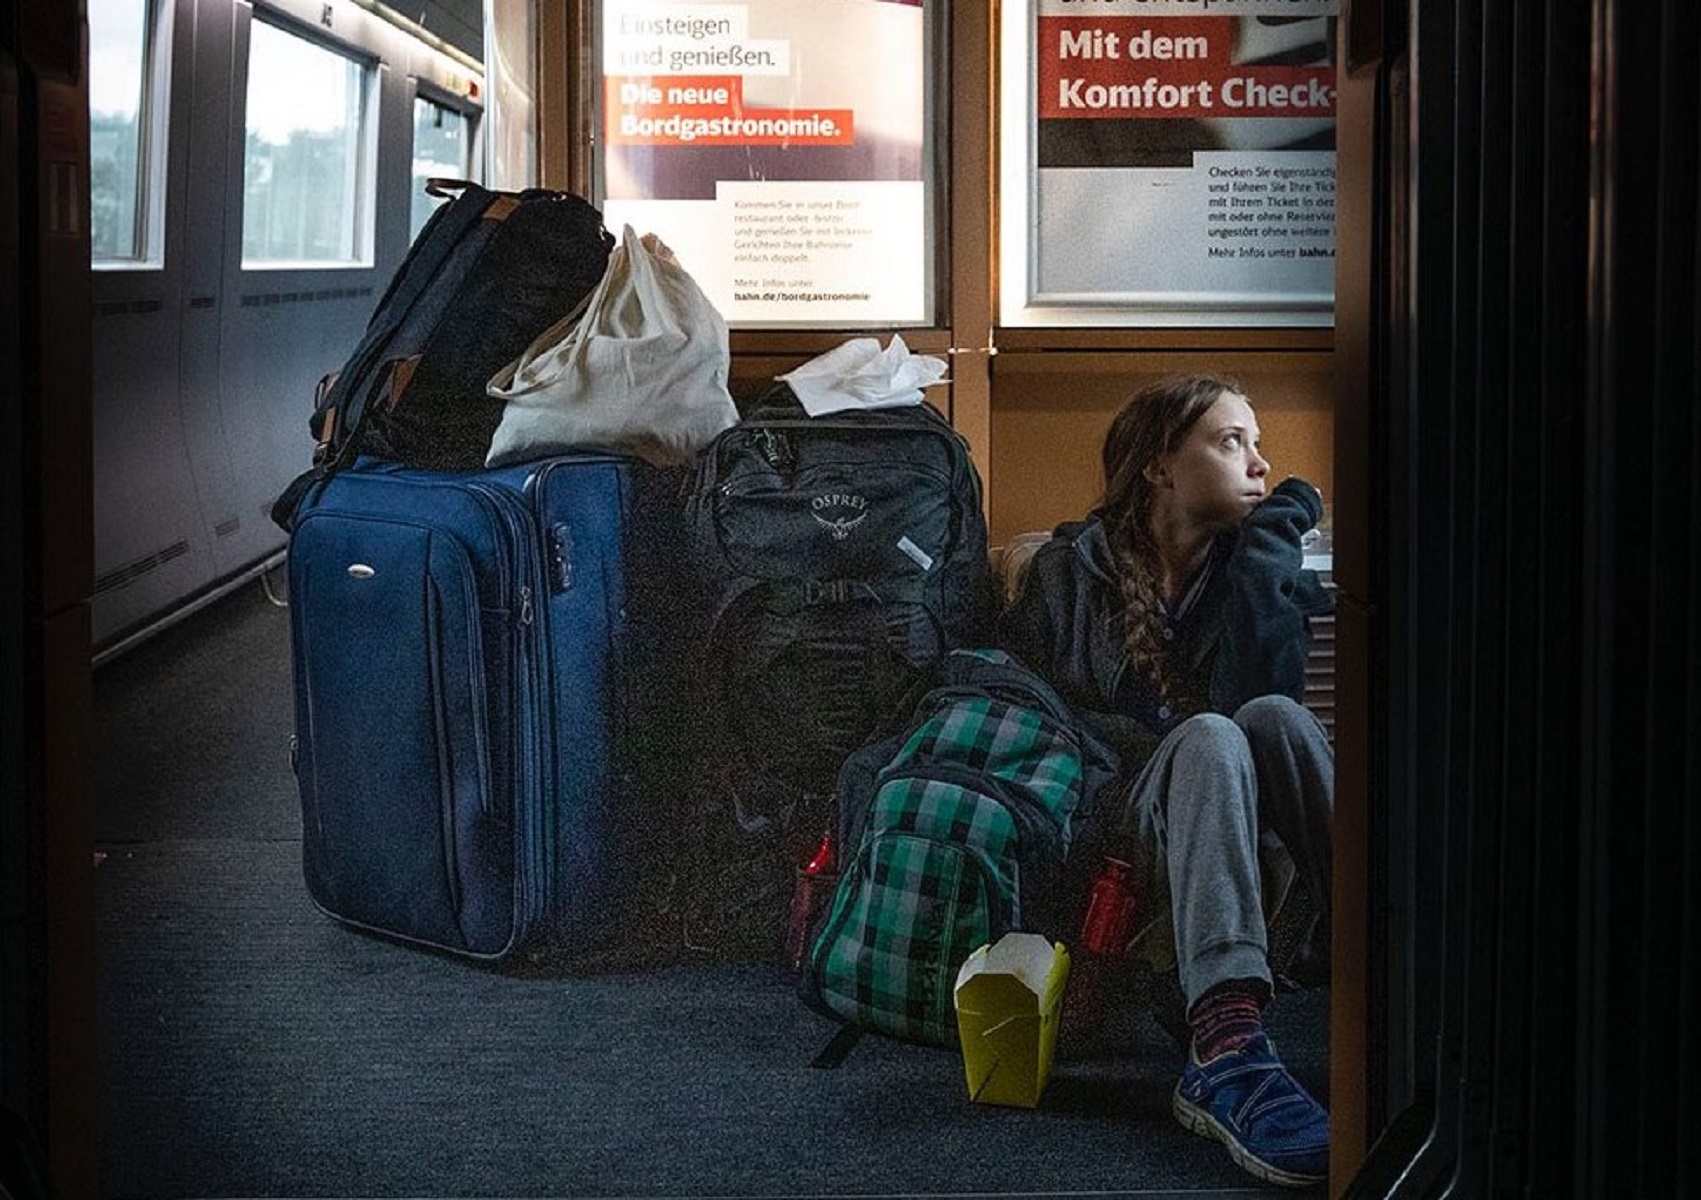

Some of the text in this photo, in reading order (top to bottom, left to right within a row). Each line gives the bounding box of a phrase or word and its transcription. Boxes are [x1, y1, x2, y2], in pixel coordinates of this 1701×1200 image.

[621, 14, 730, 39] Einsteigen
[1059, 30, 1208, 59] Mit dem
[620, 45, 775, 71] und genießen.
[621, 84, 728, 104] Die neue
[1059, 78, 1212, 109] Komfort
[621, 114, 841, 139] Bordgastronomie.
[1208, 167, 1252, 177] Checken
[1255, 167, 1270, 177] Sie
[1208, 182, 1229, 192] und
[1232, 182, 1267, 192] führen
[1270, 182, 1286, 192] Sie
[1289, 182, 1311, 192] Ihre
[1208, 197, 1227, 207] mit
[1231, 197, 1262, 207] Ihrem
[1267, 197, 1300, 207] Ticket
[1302, 197, 1313, 207] in
[1208, 213, 1227, 221] mit
[1229, 212, 1254, 221] oder
[1257, 212, 1283, 221] ohne
[1208, 227, 1330, 239] ungestört ohne weitere
[1208, 247, 1235, 257] Mehr
[1239, 247, 1265, 258] Infos
[1267, 248, 1296, 257] unter
[734, 279, 758, 287] Mehr
[734, 292, 870, 302] bahn.de/bordgastronomie
[811, 494, 869, 510] OSPREY
